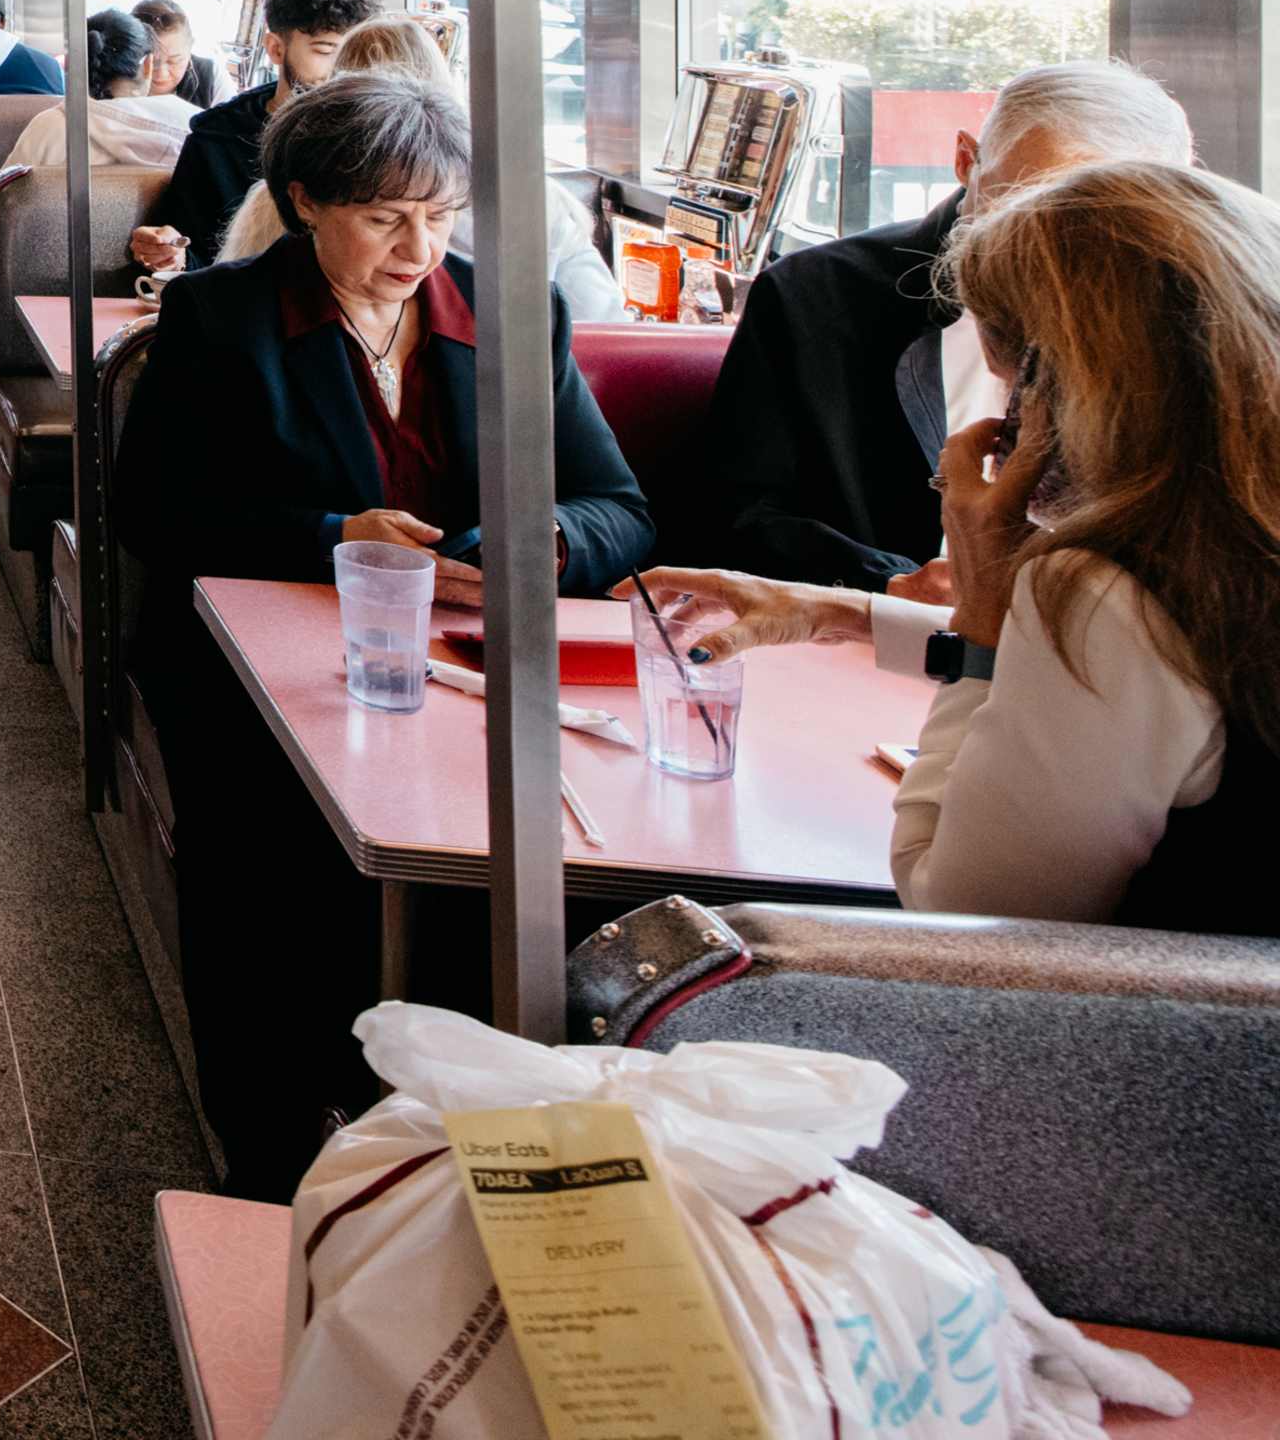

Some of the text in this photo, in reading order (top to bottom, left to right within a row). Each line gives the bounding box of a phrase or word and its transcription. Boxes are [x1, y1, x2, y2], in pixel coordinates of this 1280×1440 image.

[460, 1140, 549, 1158] Uber Eats
[560, 1163, 623, 1185] LaQuan
[545, 1240, 625, 1261] DELIVERY
